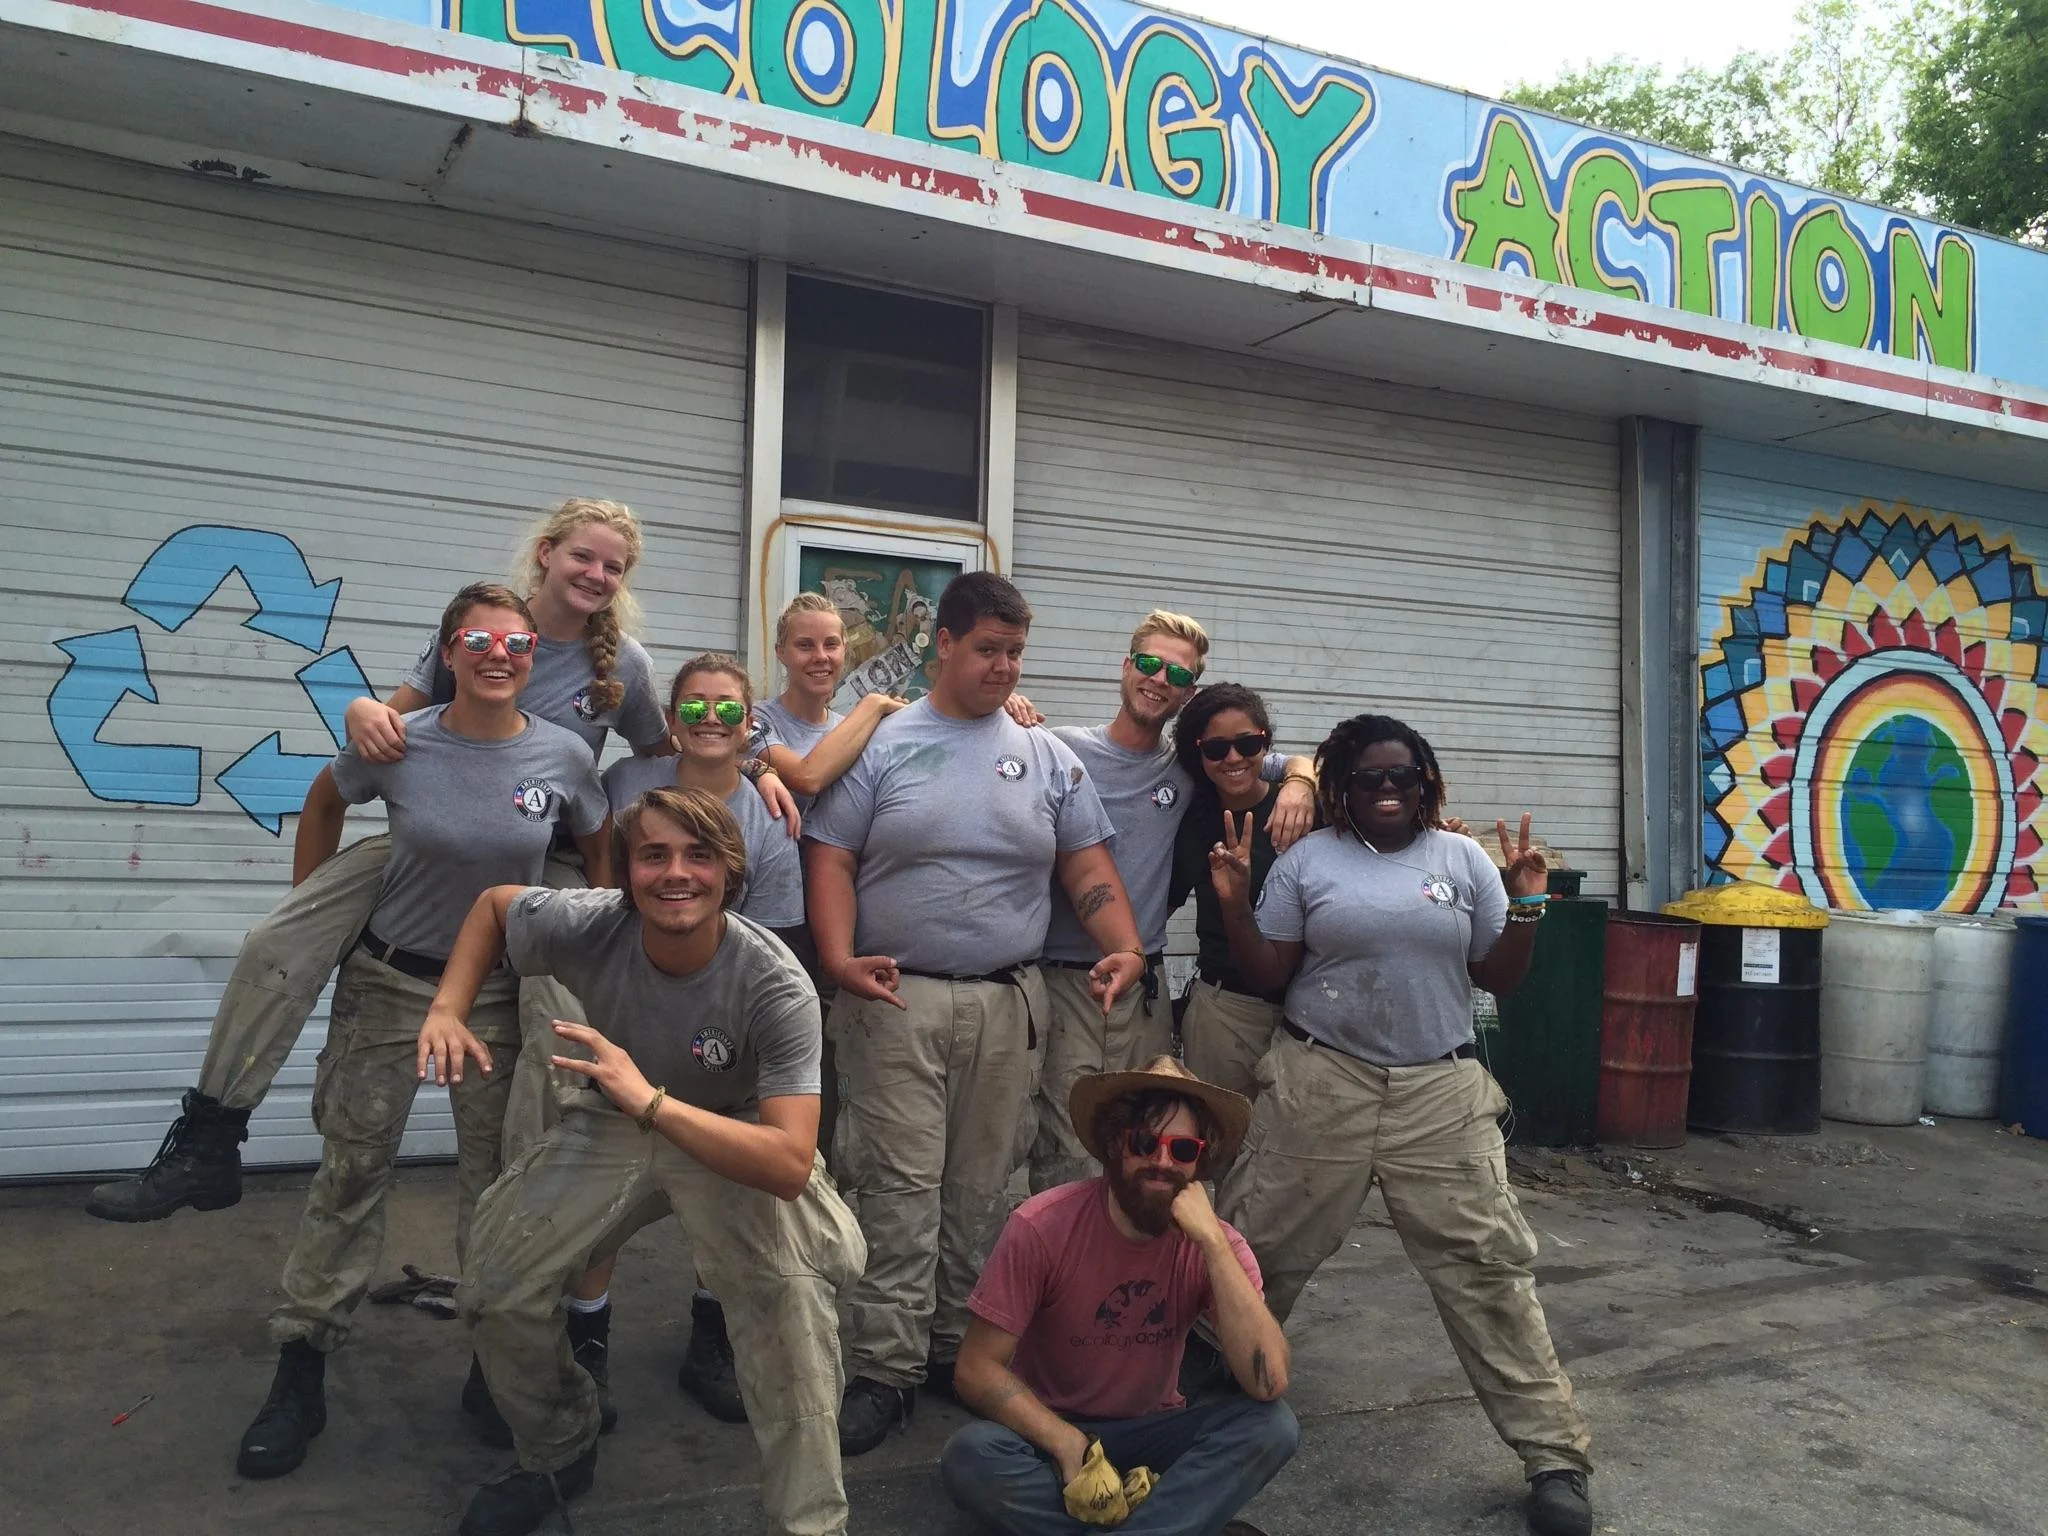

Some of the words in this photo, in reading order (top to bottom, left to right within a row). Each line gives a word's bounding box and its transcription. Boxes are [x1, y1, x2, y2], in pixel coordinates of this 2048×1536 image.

[1448, 108, 1977, 374] ACTION
[527, 789, 542, 808] A
[706, 1041, 724, 1062] A
